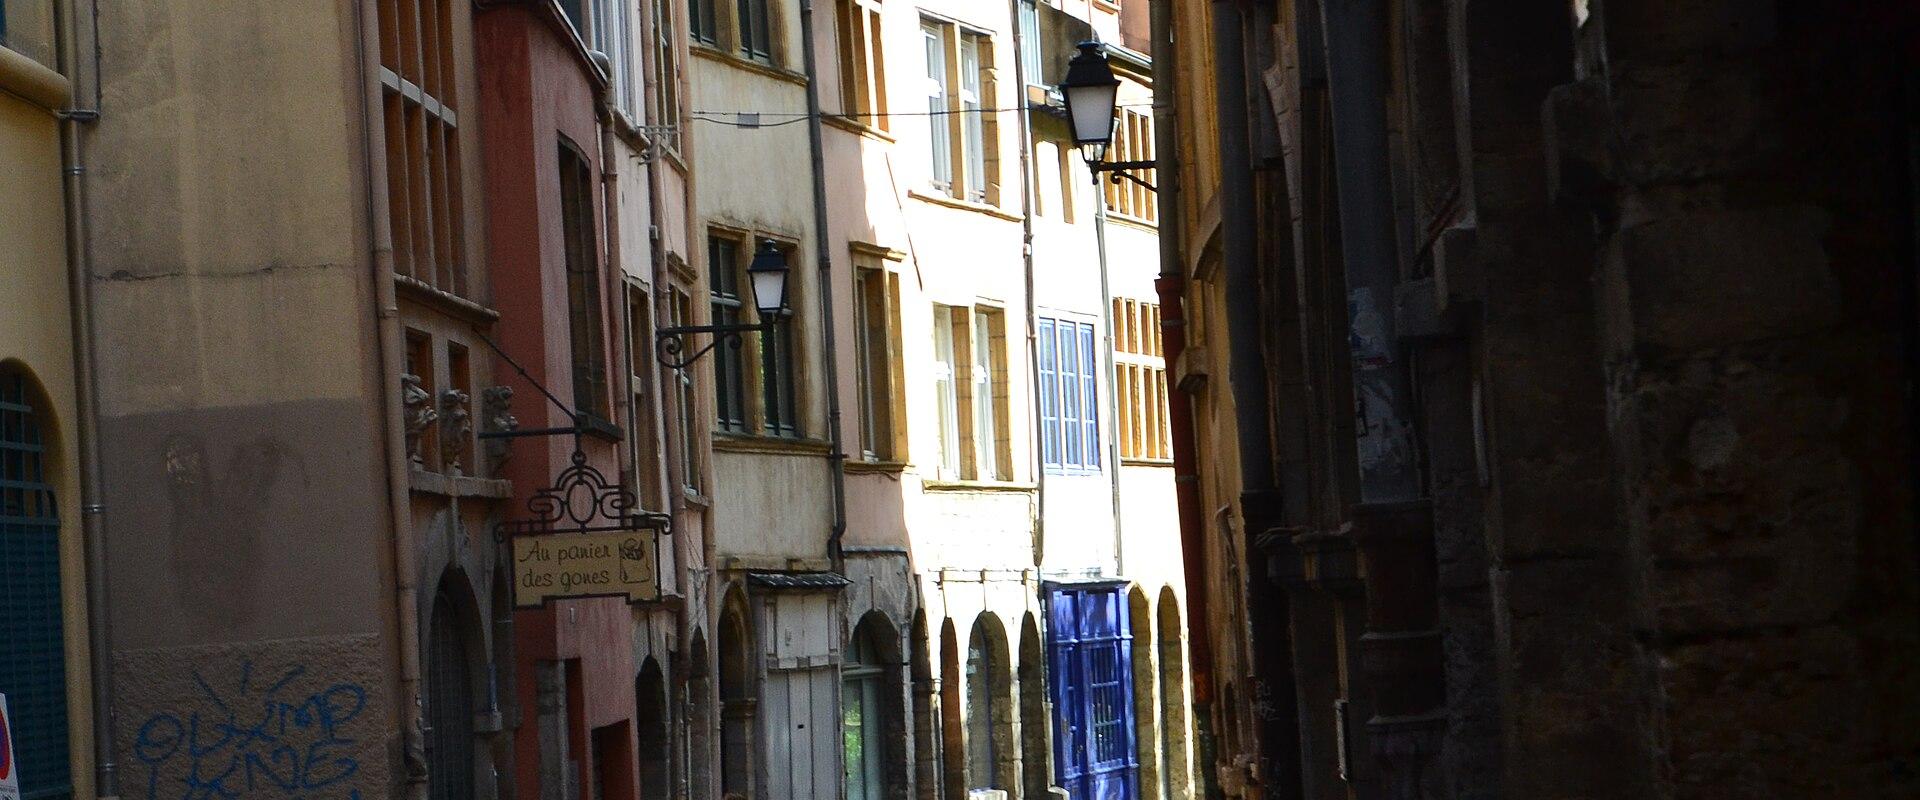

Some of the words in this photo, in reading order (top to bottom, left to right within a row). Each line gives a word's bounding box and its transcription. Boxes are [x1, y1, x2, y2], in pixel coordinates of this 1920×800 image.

[519, 540, 551, 562] Au
[558, 543, 612, 565] panier
[522, 568, 553, 588] des
[560, 570, 611, 592] gones
